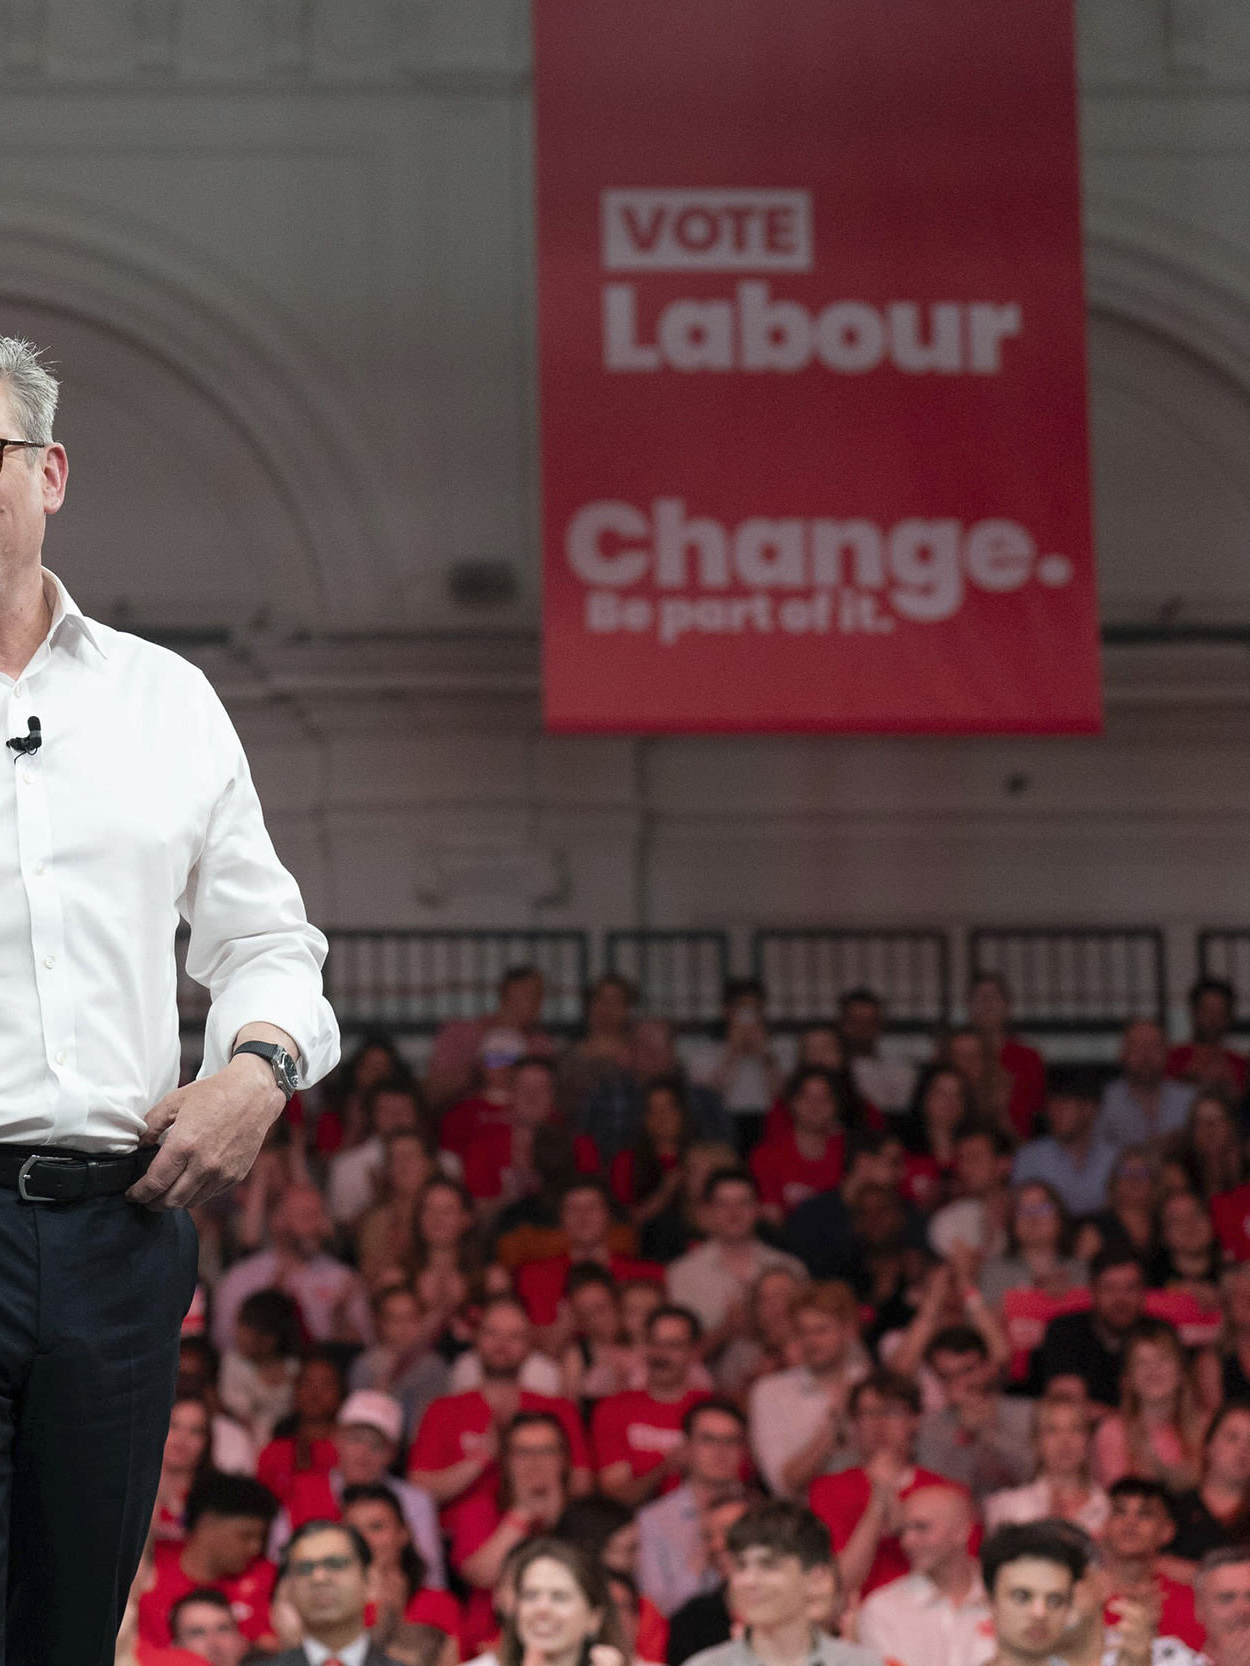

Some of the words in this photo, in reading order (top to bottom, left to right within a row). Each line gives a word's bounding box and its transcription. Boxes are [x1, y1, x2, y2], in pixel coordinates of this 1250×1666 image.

[620, 208, 796, 255] VOTE
[602, 282, 1021, 374] Labour
[566, 498, 1073, 621] Change.
[586, 595, 651, 633] Be
[657, 595, 776, 645] part
[780, 590, 834, 633] of
[840, 588, 896, 633] it.
